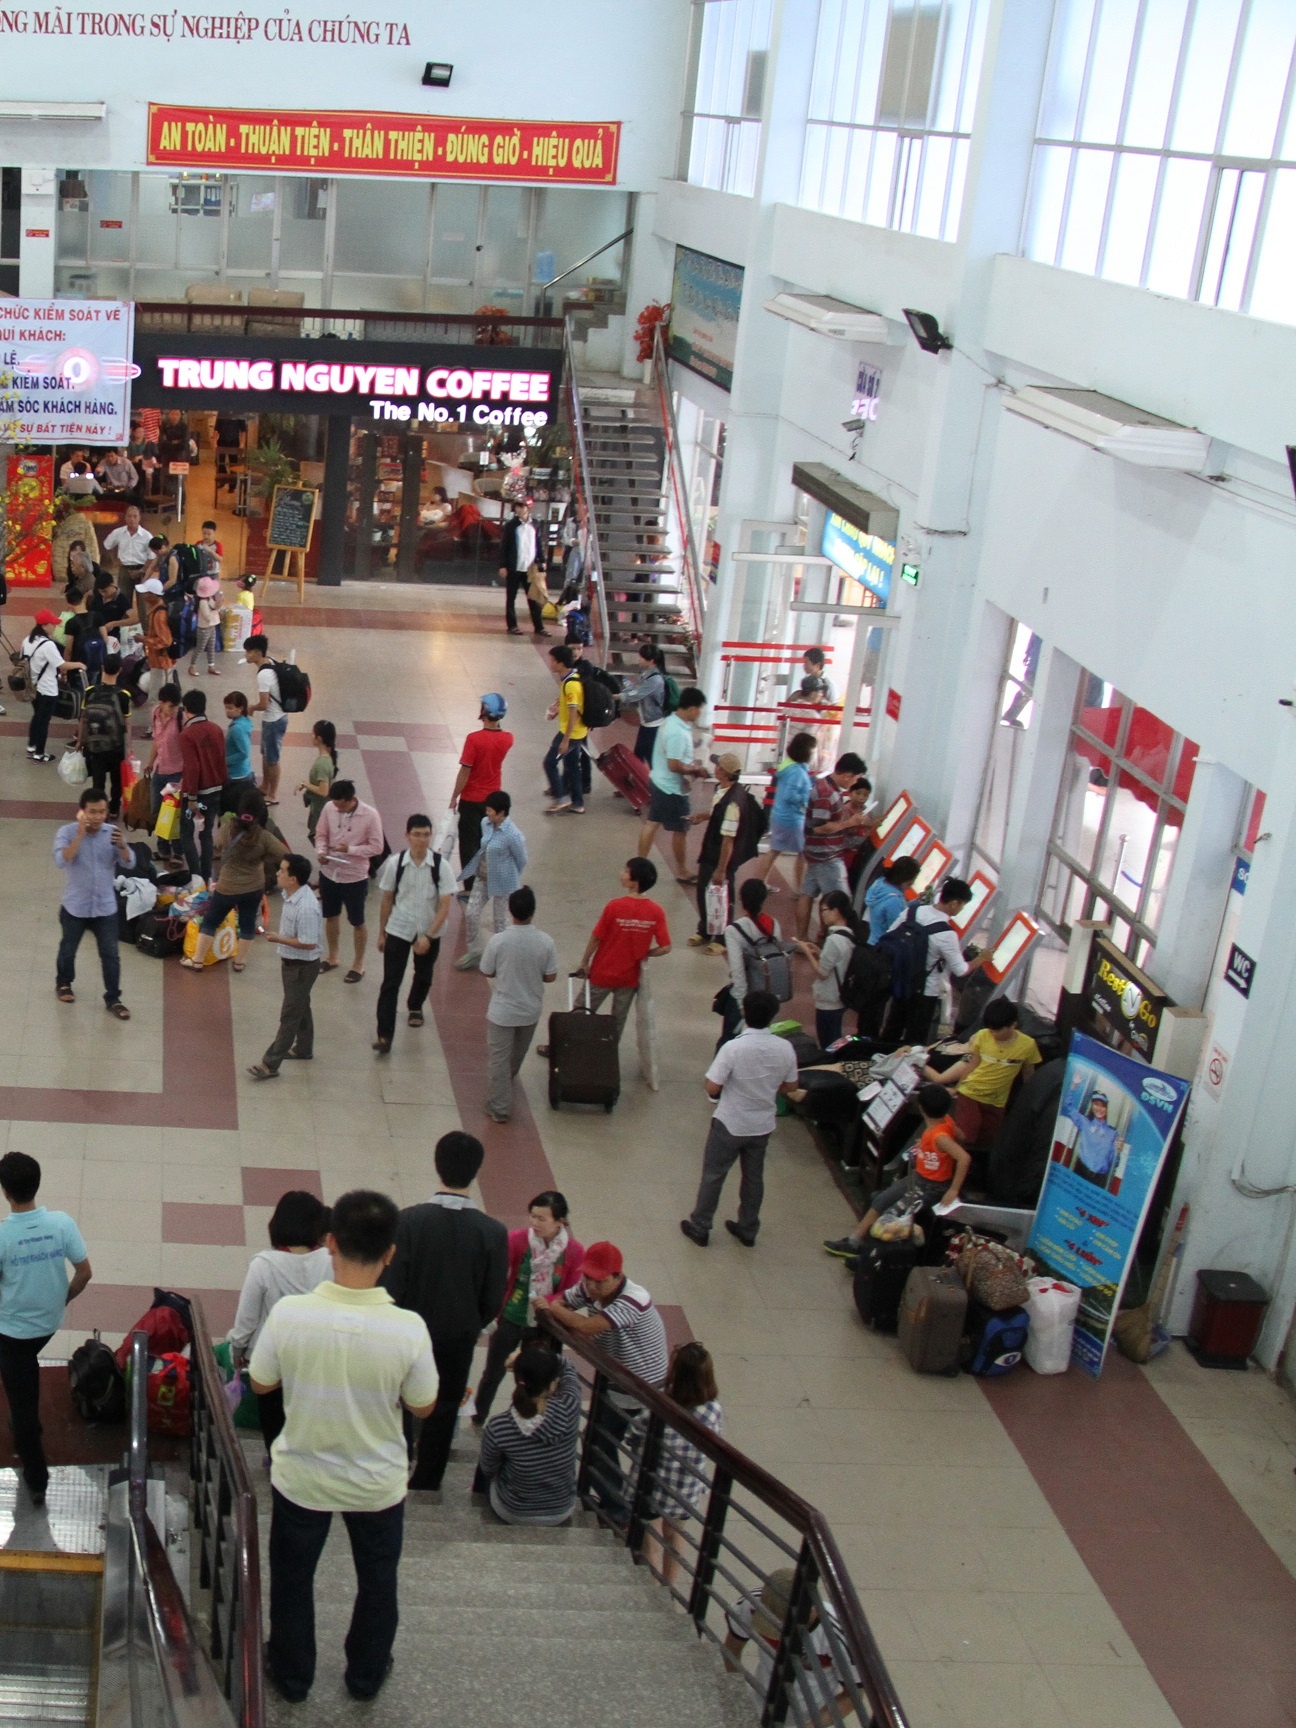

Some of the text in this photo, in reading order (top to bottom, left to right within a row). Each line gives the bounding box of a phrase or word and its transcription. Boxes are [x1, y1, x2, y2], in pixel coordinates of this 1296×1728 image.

[33, 6, 73, 34] MÃI
[77, 12, 145, 37] TRONG
[150, 9, 178, 41] SỰ
[180, 11, 259, 44] NGHIỆP
[264, 9, 304, 42] CỦA
[308, 15, 380, 44] CHÚNG
[385, 23, 412, 46] TA
[159, 115, 603, 175] AN TOÀN THUẬN TIỆN THÂN THIỆN ĐÚNG GIỜ HIỆU QUẢ
[19, 326, 66, 342] KHÁCH:
[157, 358, 551, 402] TRUNG NGUYEN COFFEE
[369, 400, 548, 426] The No.1 Coffee
[1233, 950, 1251, 978] WC
[1098, 959, 1126, 996] Rest
[1139, 1000, 1157, 1027] Go
